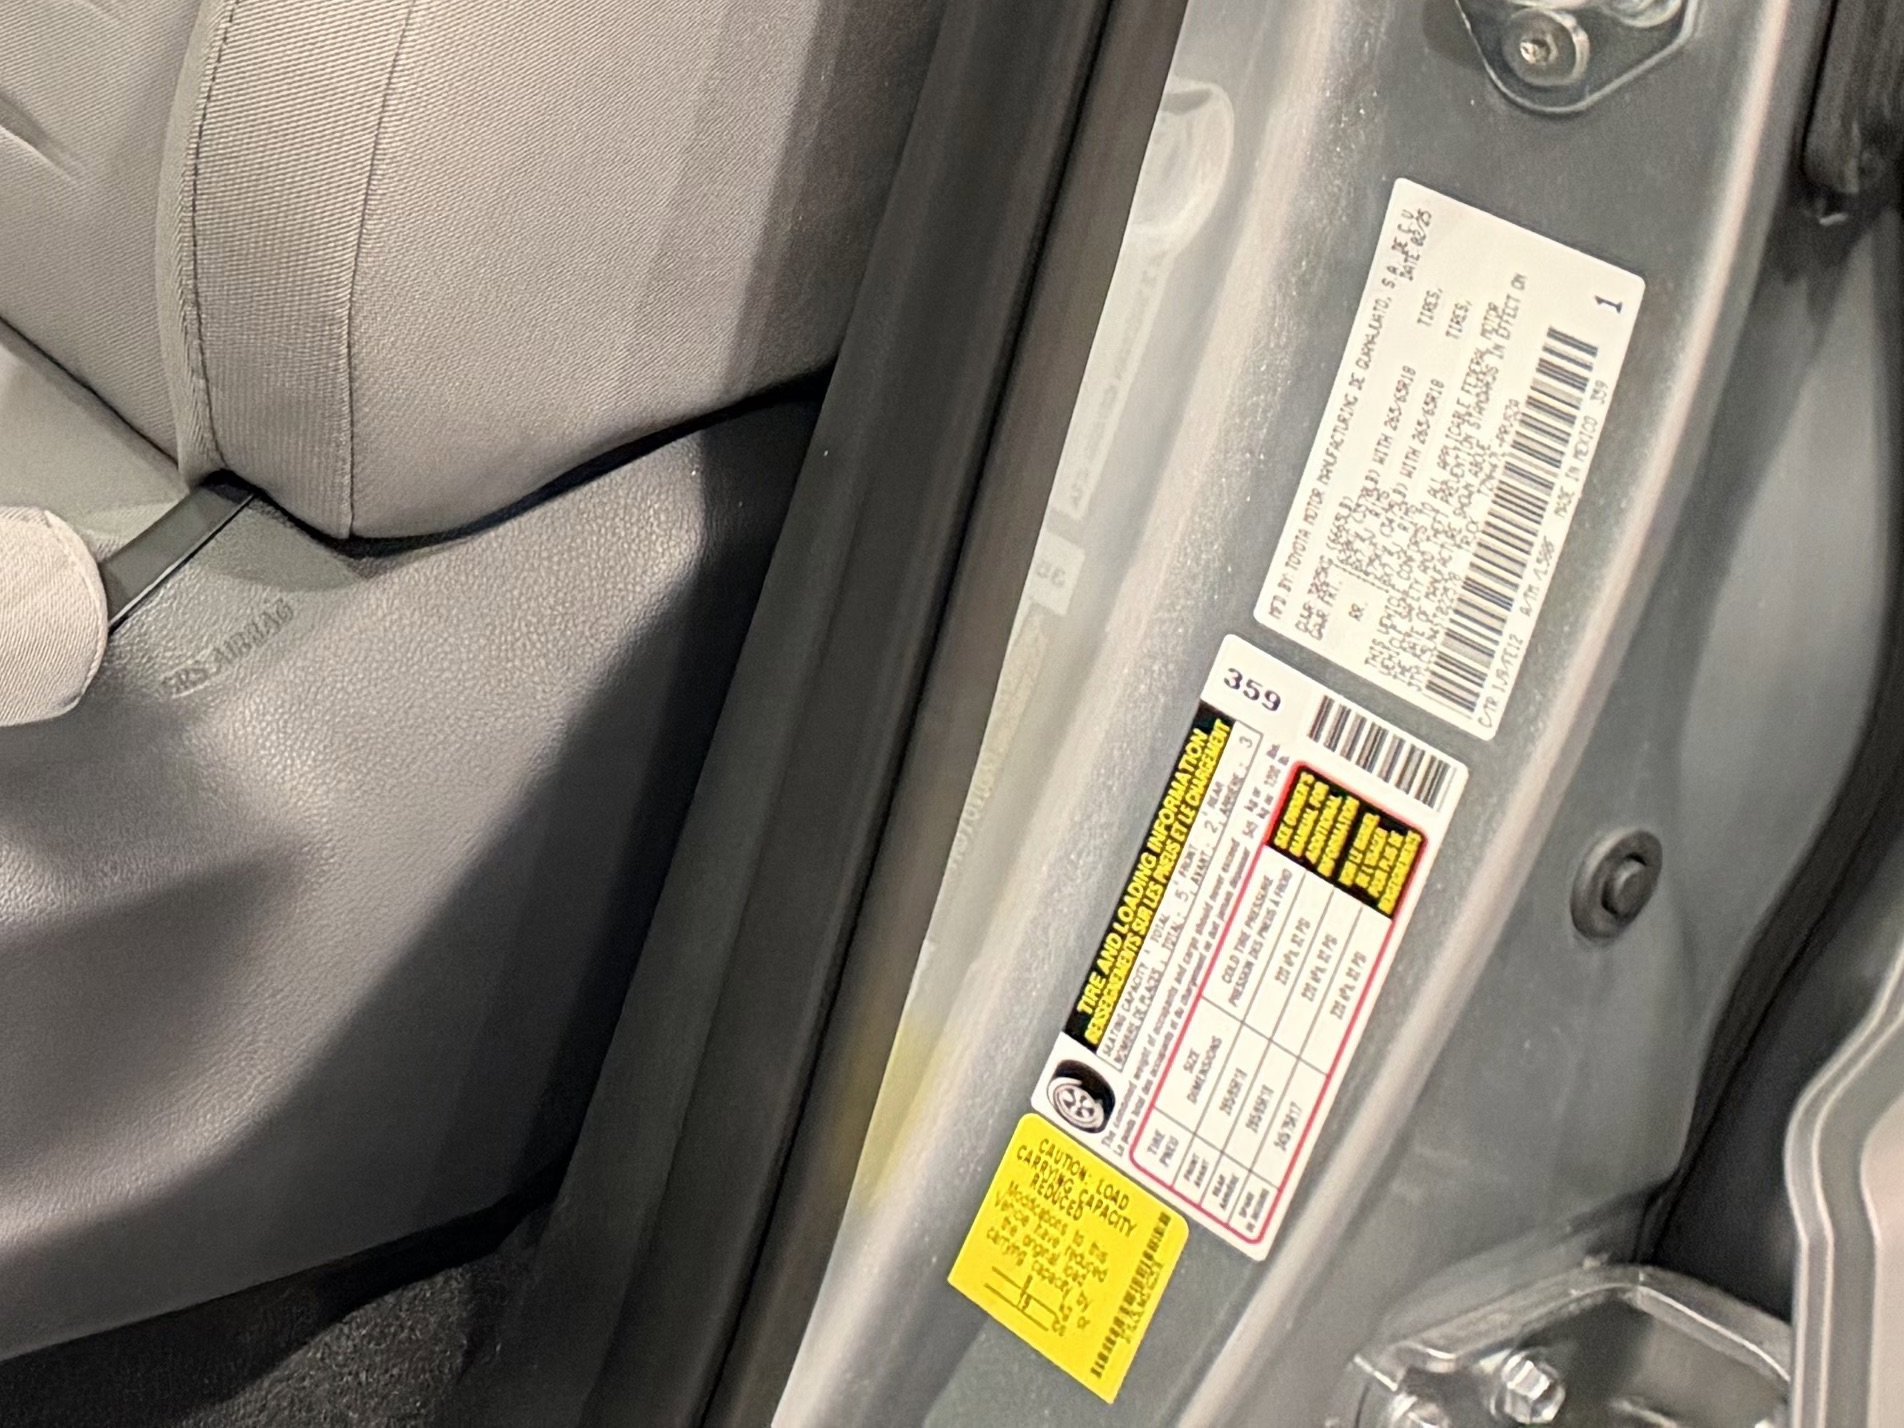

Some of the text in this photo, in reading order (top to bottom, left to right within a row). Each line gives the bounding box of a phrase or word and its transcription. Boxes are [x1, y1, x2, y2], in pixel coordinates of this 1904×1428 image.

[1370, 431, 1394, 466] WITH
[1382, 363, 1417, 432] 265/65R18
[1416, 283, 1443, 329] TIRES,
[1464, 362, 1499, 430] STANDARDS
[1493, 292, 1522, 341] EFFECT
[1509, 270, 1528, 292] ON
[1591, 290, 1624, 314] 1
[1284, 525, 1311, 572] TOYOTA
[1301, 486, 1325, 526] MOTOR
[1315, 391, 1358, 487] MANUFACTURING
[1347, 372, 1365, 391] DE
[1390, 236, 1408, 255] DE
[1398, 444, 1422, 479] WITH
[1410, 375, 1445, 444] 265/65R18
[1444, 295, 1472, 342] TIRES,
[1435, 397, 1471, 471] APPLICABLE
[1460, 345, 1488, 396] FEDERAL
[1477, 300, 1502, 340] MOTOR
[1570, 413, 1599, 463] MEXICO
[1220, 663, 1285, 715] 359
[1076, 726, 1209, 1018] TIRE AND LOADING INFORMATION
[1083, 717, 1231, 1047] RENSEIGNEMENTS SUR LES PNEUS ET LE CHARGEMENT
[1120, 960, 1149, 1014] CAPACITY
[1173, 887, 1190, 903] 5
[1202, 818, 1219, 834] 2
[1237, 733, 1255, 750] 3
[1017, 1145, 1137, 1237] CARRYING CAPACITY
[1030, 1173, 1084, 1221] REDUCED
[1096, 1178, 1130, 1211] LOAD
